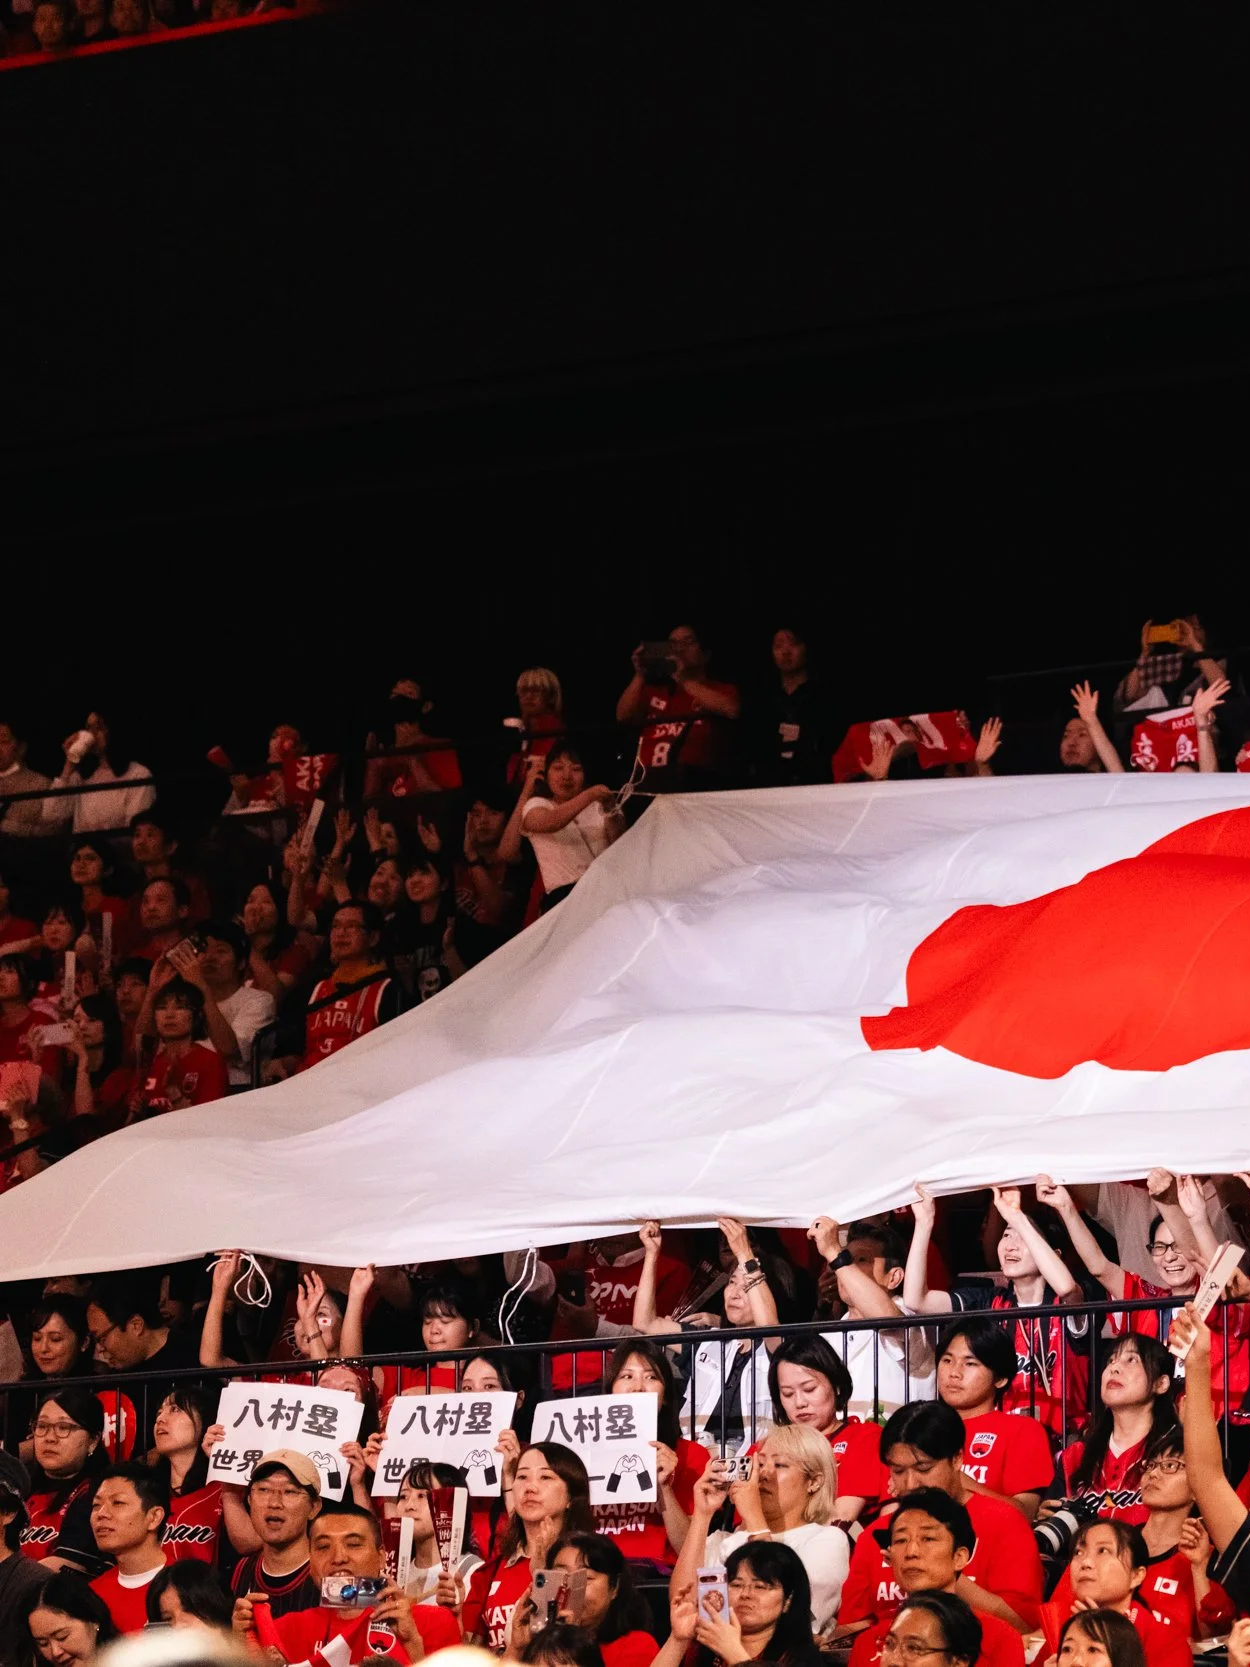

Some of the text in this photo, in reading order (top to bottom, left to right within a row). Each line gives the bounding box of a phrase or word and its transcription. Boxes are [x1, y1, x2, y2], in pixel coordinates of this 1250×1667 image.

[1171, 716, 1196, 730] AKAT
[652, 742, 671, 767] 8
[232, 1397, 339, 1440] 八村塁
[400, 1401, 493, 1437] 八村塁
[543, 1404, 638, 1444] 八村塁
[833, 1442, 847, 1450] PAN
[975, 1433, 995, 1441] JAPAN
[211, 1448, 264, 1474] 世界
[160, 1523, 215, 1545] pan
